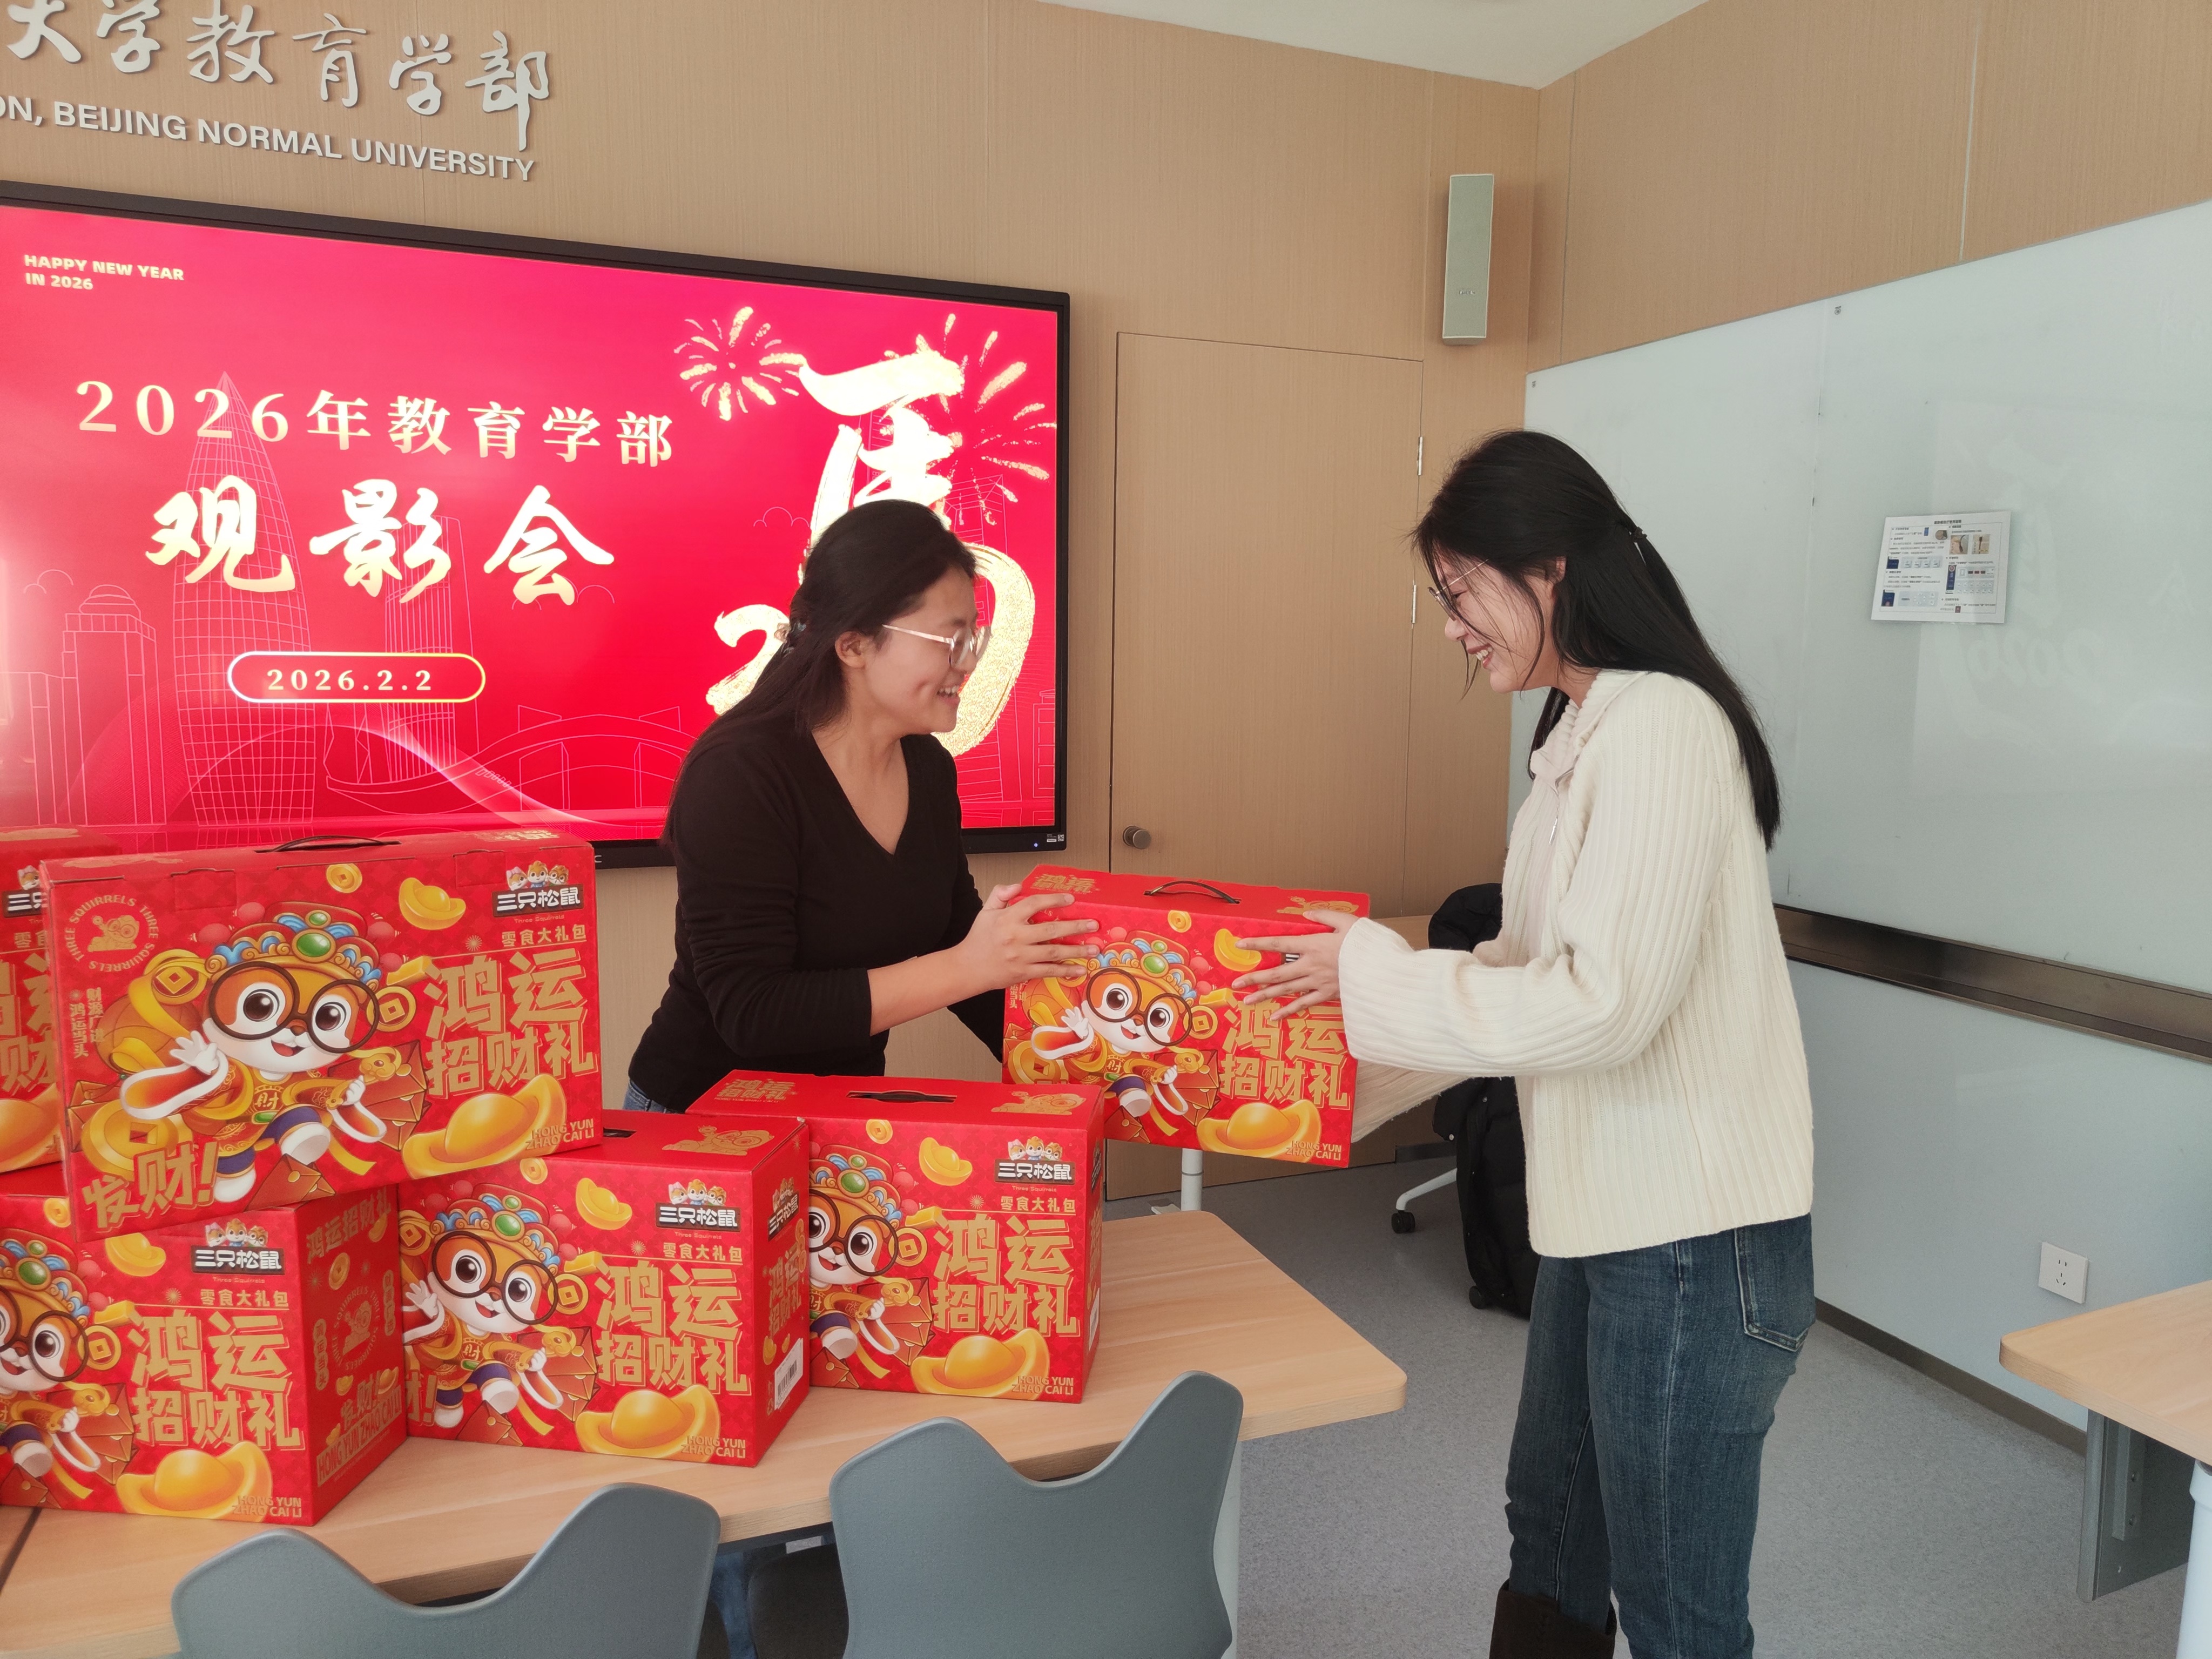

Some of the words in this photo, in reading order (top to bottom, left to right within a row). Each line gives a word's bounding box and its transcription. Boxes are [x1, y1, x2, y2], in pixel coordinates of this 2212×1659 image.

[0, 96, 43, 126] N,
[54, 101, 186, 140] BEIJING
[198, 118, 342, 159] NORMAL
[352, 138, 534, 181] UNIVERSITY
[24, 254, 87, 272] HAPPY
[92, 261, 133, 276] NEW
[137, 265, 185, 281] YEAR
[25, 273, 45, 286] IN
[51, 275, 93, 290] 2026
[76, 380, 673, 468] 2026年教育学部
[145, 475, 615, 605] 观影会
[267, 669, 431, 691] 2026.2.2
[69, 894, 137, 923] SQUIRRELS
[497, 887, 581, 912] 三只松鼠
[502, 924, 586, 947] 零食大礼包
[423, 948, 583, 1040] 鸿运
[70, 1002, 89, 1058] 鸿运当头
[1222, 996, 1345, 1065] 鸿运
[426, 1021, 594, 1096] 招财礼
[1219, 1053, 1348, 1107] 招财礼
[525, 1135, 559, 1150] ZHAO
[563, 1130, 582, 1143] CAI
[585, 1128, 594, 1138] LI
[532, 1124, 567, 1139] HONG
[570, 1118, 594, 1131] YUN
[1286, 1147, 1312, 1157] ZHAO
[1316, 1151, 1331, 1159] CAI
[1333, 1152, 1341, 1161] LI
[1291, 1140, 1320, 1150] HONG
[1323, 1143, 1341, 1152] YUN
[998, 1162, 1072, 1180] 三只松鼠
[1001, 1196, 1076, 1212] 零食大礼包
[659, 1206, 738, 1227] 三只松鼠
[195, 1249, 282, 1270] 三只松鼠
[663, 1242, 743, 1262] 零食大礼包
[933, 1213, 1070, 1287] 鸿运
[200, 1289, 289, 1307] 零食大礼包
[595, 1260, 739, 1341] 鸿运
[933, 1282, 1077, 1333] 招财礼
[127, 1309, 288, 1392] 鸿运
[596, 1331, 748, 1392] 招财礼
[1011, 1384, 1042, 1394] ZHAO
[1045, 1385, 1062, 1395] CAI
[1065, 1386, 1074, 1395] LI
[1018, 1375, 1049, 1385] HONG
[1051, 1377, 1074, 1386] YUN
[131, 1387, 301, 1446] 招财礼
[681, 1444, 714, 1456] ZHAO
[716, 1447, 734, 1458] CAI
[737, 1449, 746, 1459] LI
[687, 1435, 720, 1447] HONG
[723, 1438, 746, 1448] YUN
[232, 1505, 266, 1516] ZHAO
[269, 1507, 289, 1517] CAI
[292, 1508, 302, 1518] LI
[238, 1495, 273, 1506] HONG
[276, 1497, 301, 1507] YUN
